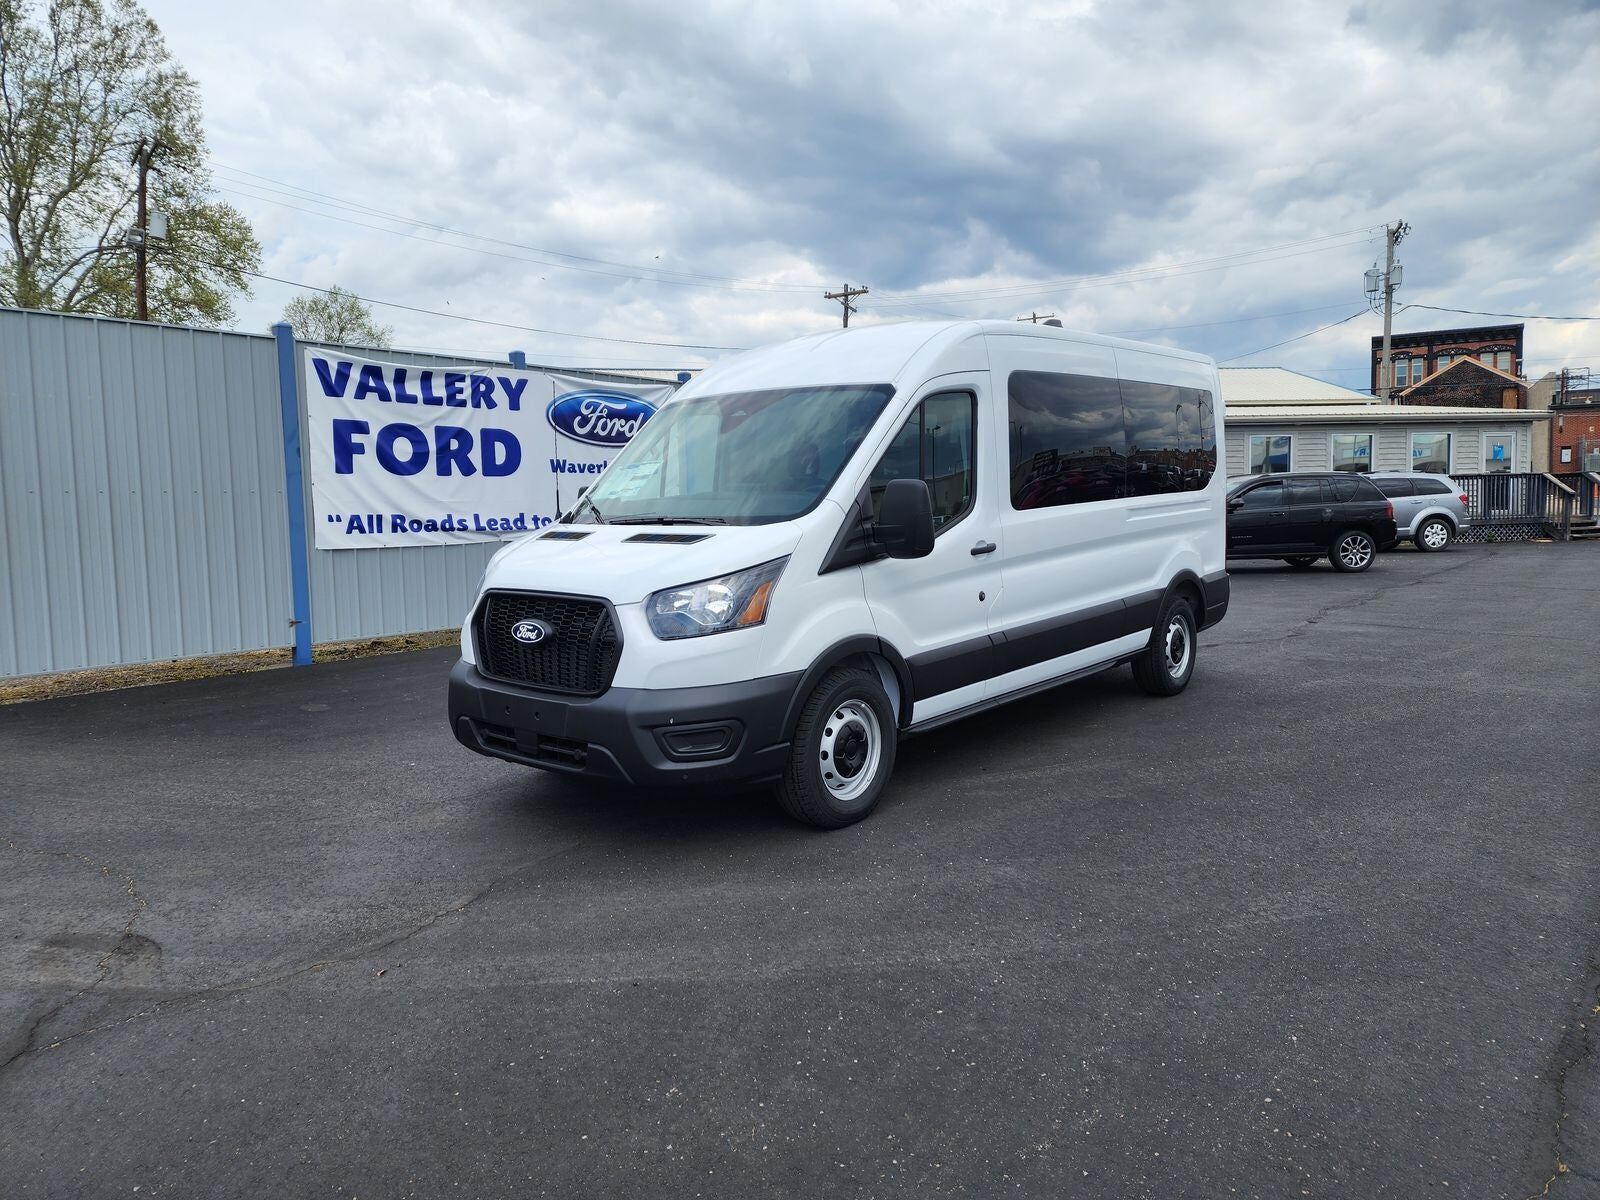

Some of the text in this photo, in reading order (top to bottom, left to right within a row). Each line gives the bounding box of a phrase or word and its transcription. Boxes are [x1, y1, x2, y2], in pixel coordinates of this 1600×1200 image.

[312, 358, 528, 411] VALLERY
[573, 398, 645, 438] Ford
[333, 419, 522, 477] FORD
[391, 513, 469, 533] Roads
[473, 512, 528, 531] Lead
[532, 514, 552, 529] to
[517, 624, 537, 640] Ford
